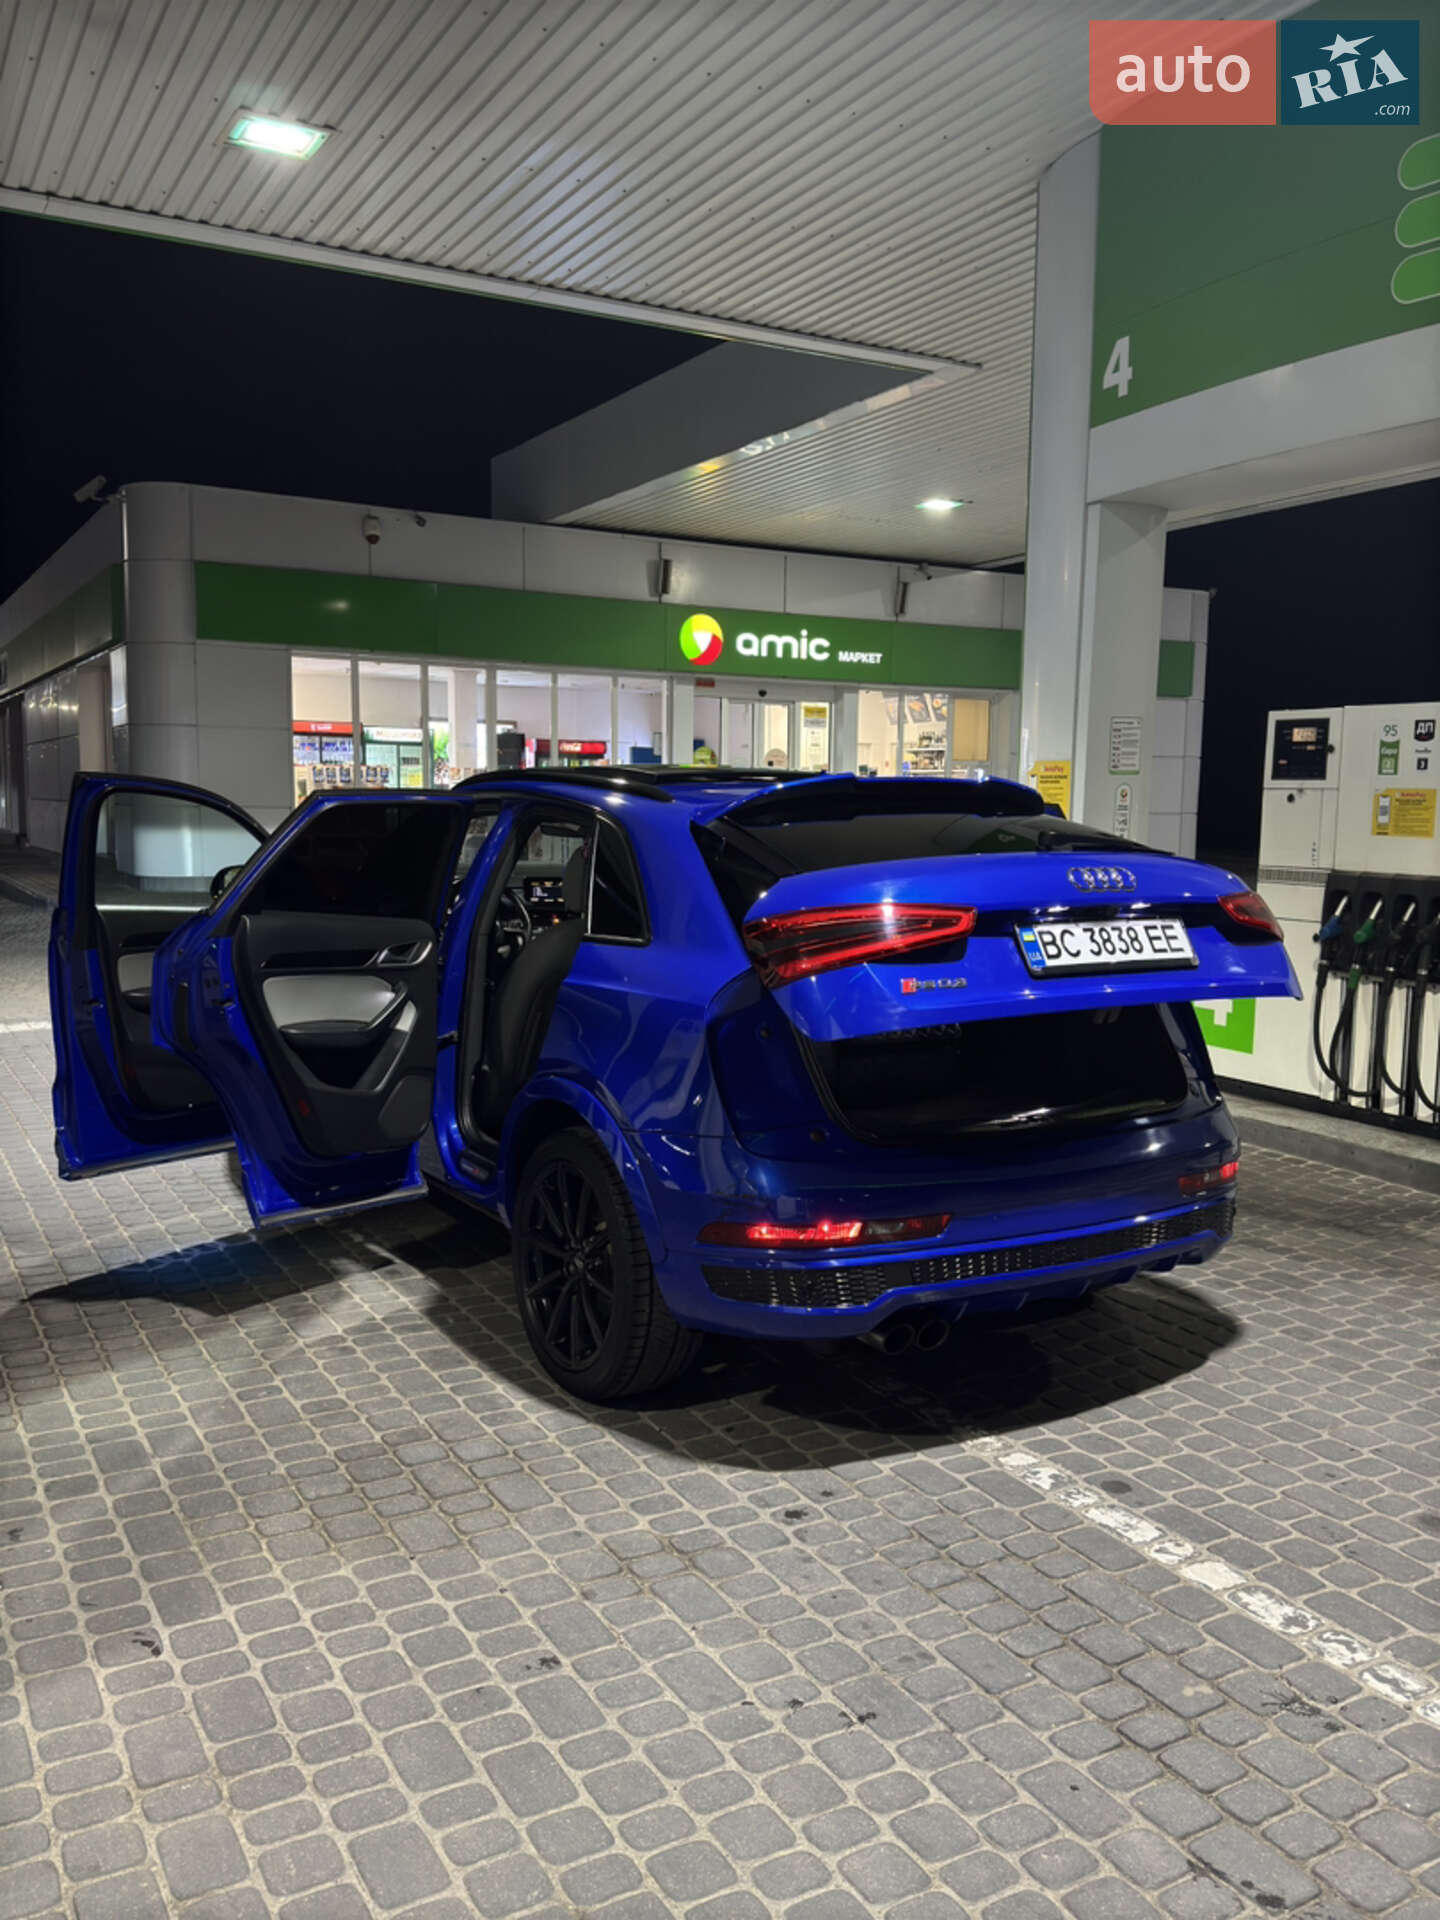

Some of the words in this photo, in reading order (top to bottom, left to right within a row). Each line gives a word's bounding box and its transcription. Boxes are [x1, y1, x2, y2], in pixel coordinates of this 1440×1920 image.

[1102, 335, 1133, 398] 4
[735, 629, 831, 661] amic
[837, 651, 883, 664] МАРКЕТ
[1384, 724, 1398, 736] 95
[1416, 722, 1433, 734] ДП
[1037, 927, 1082, 960] BC
[1083, 925, 1144, 957] 3838
[1146, 923, 1185, 954] EE
